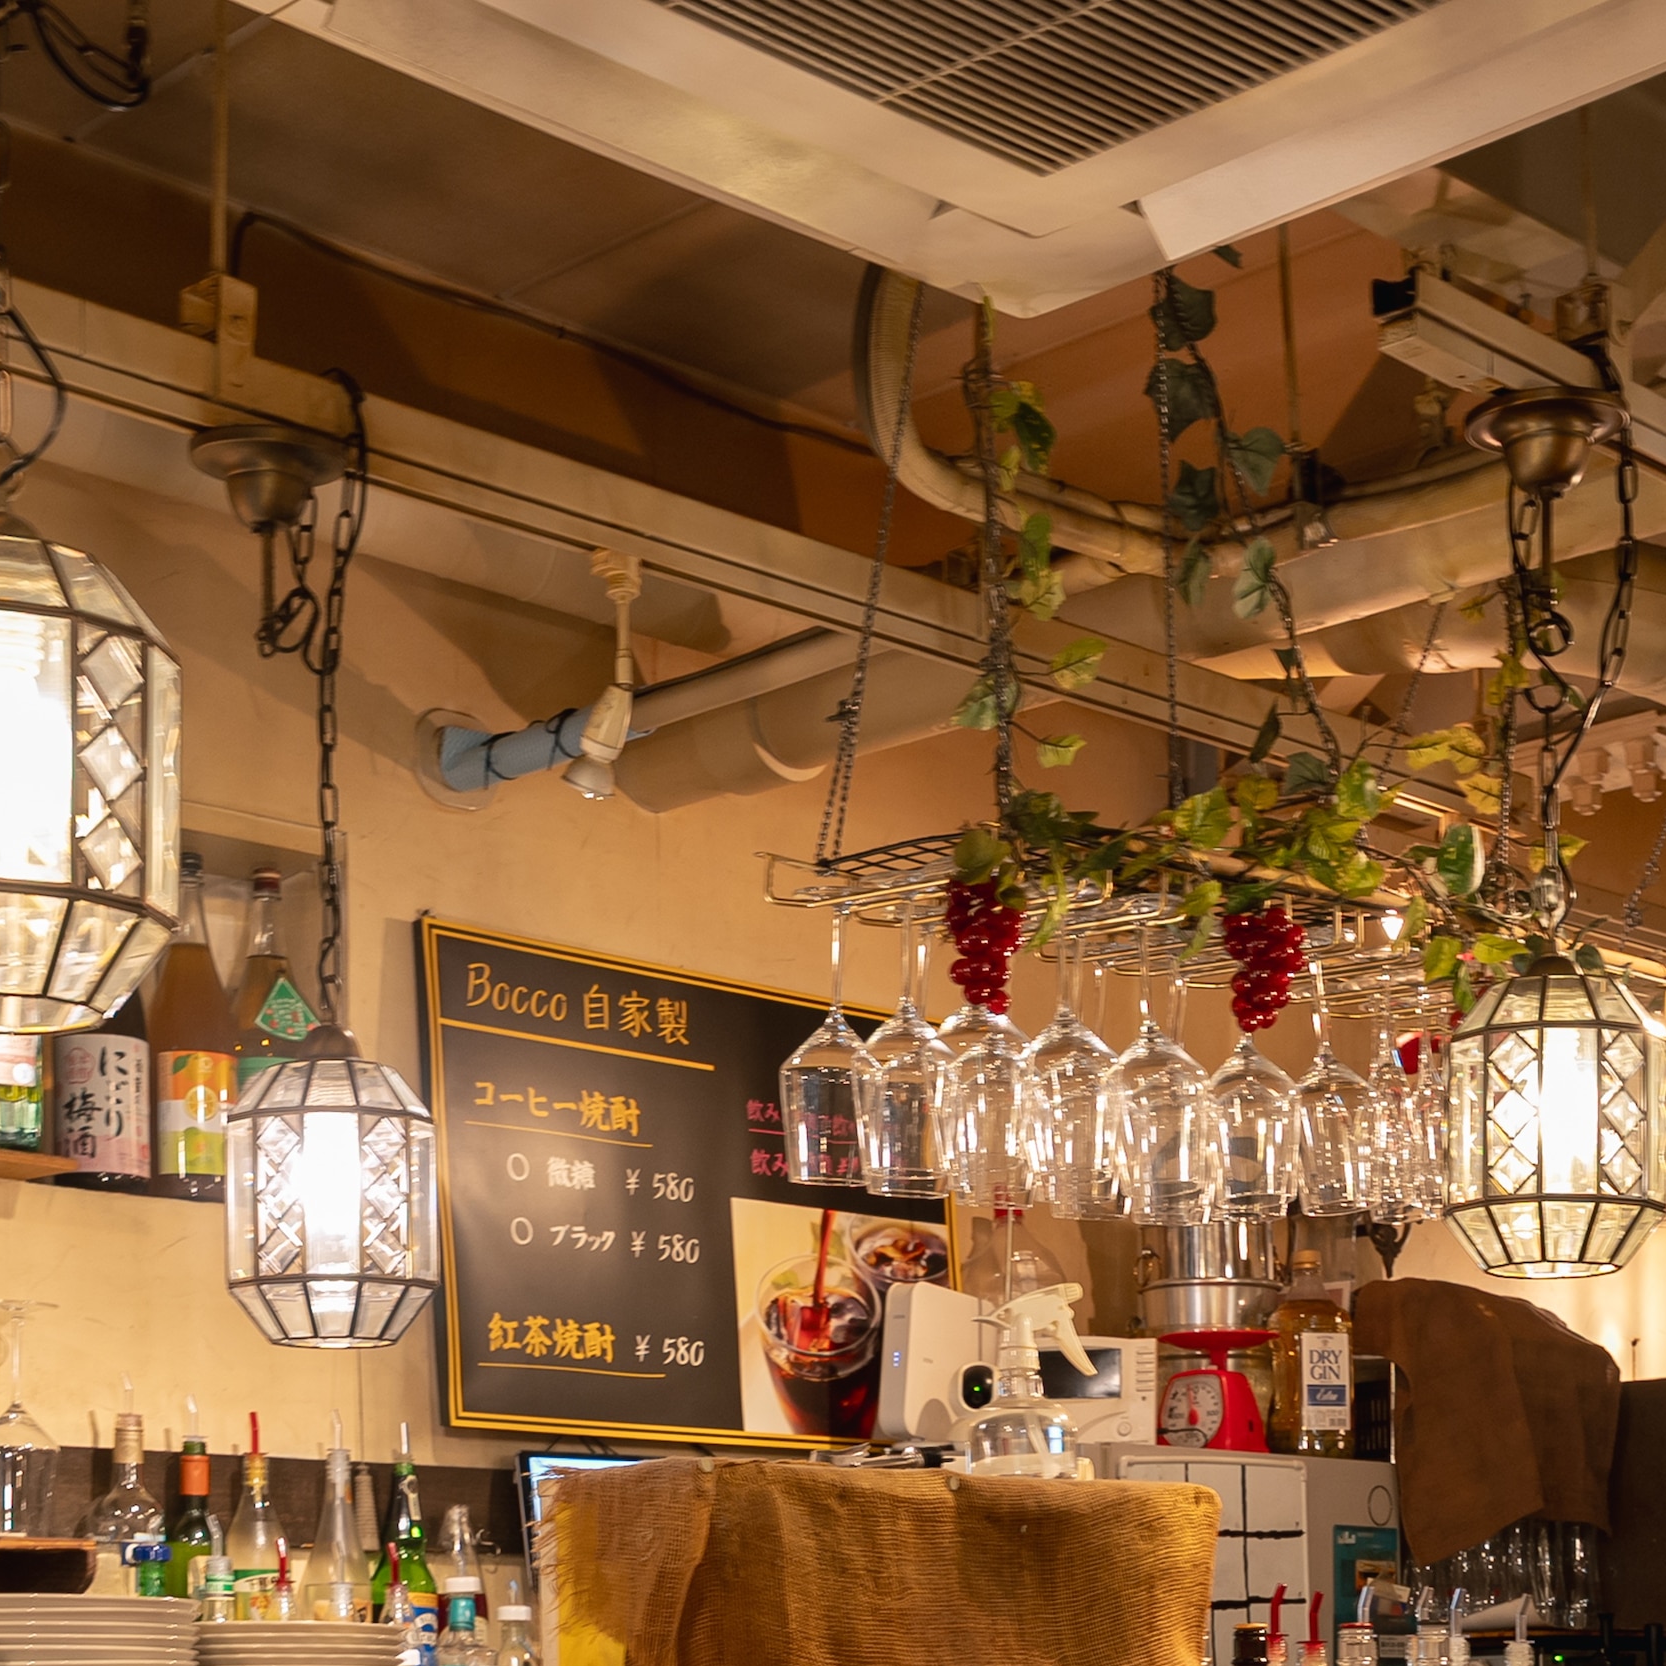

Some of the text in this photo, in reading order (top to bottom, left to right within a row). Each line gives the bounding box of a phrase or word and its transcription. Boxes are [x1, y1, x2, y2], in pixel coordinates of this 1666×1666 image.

[467, 963, 690, 1046] Bocco 自家製
[99, 1046, 129, 1137] にごり
[474, 1080, 641, 1137] コーヒー焼酎
[62, 1087, 102, 1159] 梅酒
[547, 1156, 596, 1190] 微糖
[652, 1172, 694, 1202] 580
[550, 1223, 616, 1253] ブラック
[658, 1234, 700, 1264] 580
[488, 1312, 615, 1363] 紅茶焼酎
[662, 1336, 704, 1366] 580
[1309, 1349, 1342, 1364] DRY
[1310, 1365, 1340, 1380] GIN
